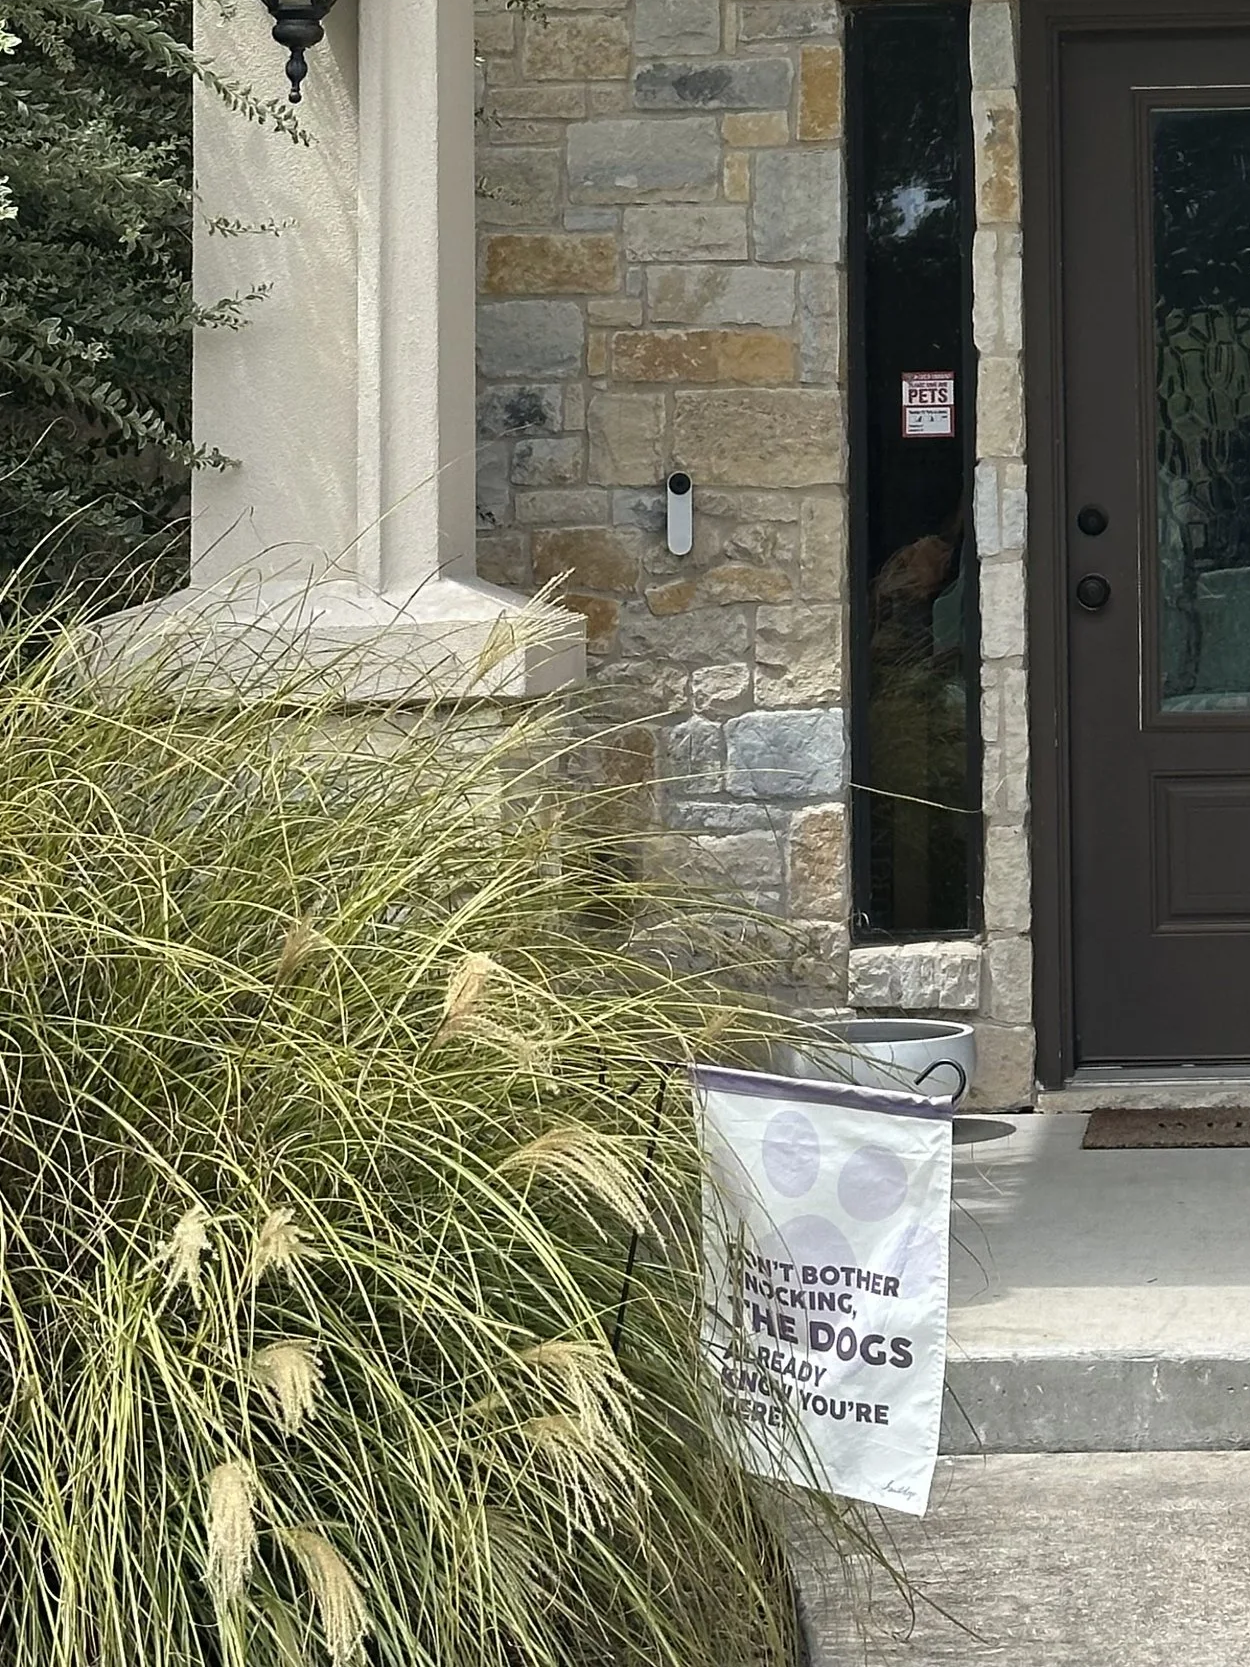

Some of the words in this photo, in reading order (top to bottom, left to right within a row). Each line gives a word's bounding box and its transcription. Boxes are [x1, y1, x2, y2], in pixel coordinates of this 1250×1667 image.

[908, 388, 948, 403] PETS
[802, 1265, 900, 1297] BOTHER
[728, 1295, 799, 1345] THE
[809, 1320, 914, 1369] DOGS
[723, 1339, 828, 1387] ALREADY
[800, 1388, 890, 1425] YOU'RE
